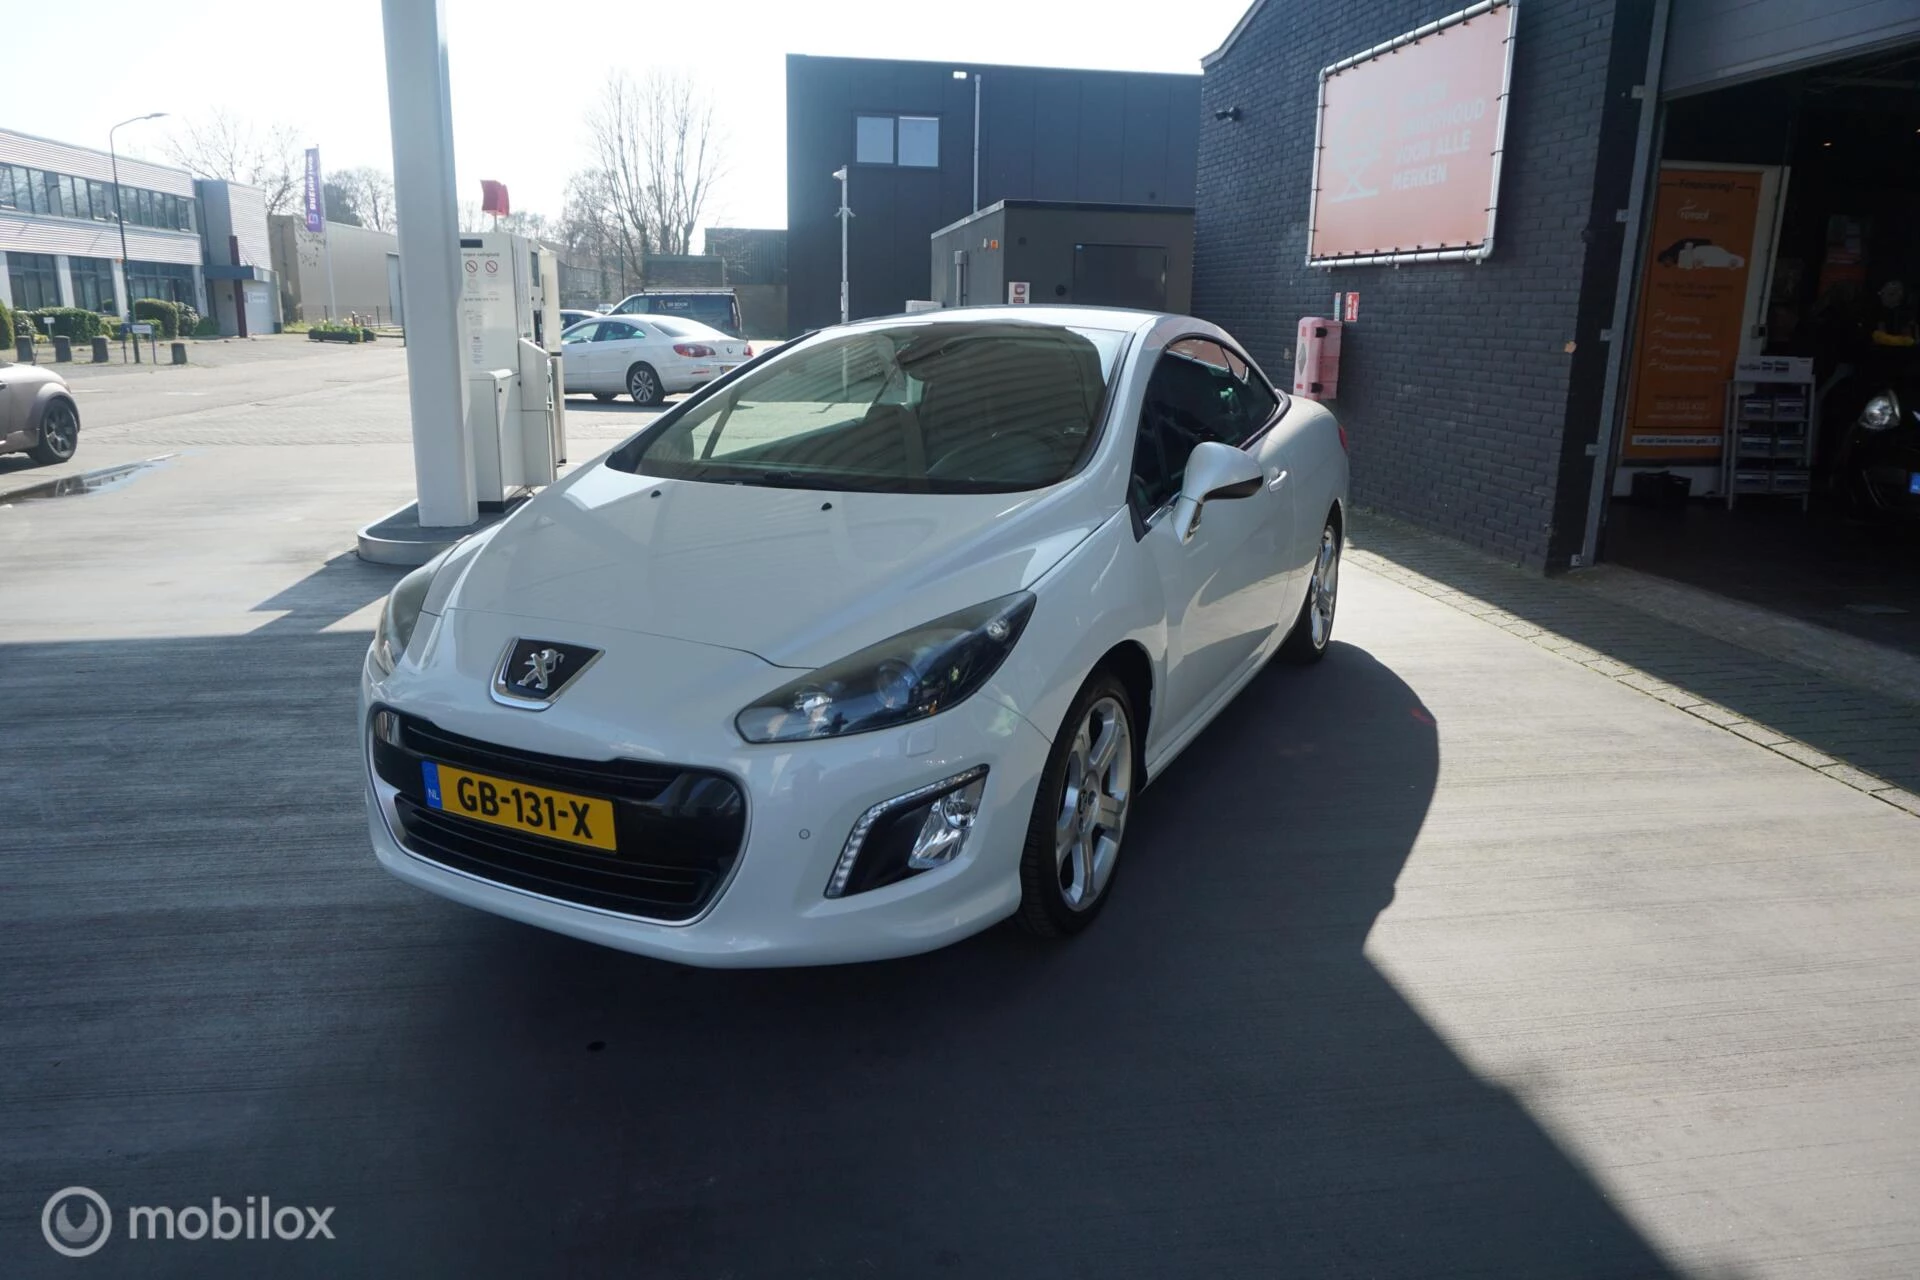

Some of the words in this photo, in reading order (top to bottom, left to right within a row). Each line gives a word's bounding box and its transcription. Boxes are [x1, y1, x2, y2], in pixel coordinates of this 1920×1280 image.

[1435, 128, 1472, 157] ALLE
[1391, 162, 1448, 191] MERKEN
[427, 788, 440, 801] NL
[457, 776, 593, 840] GB-131-X
